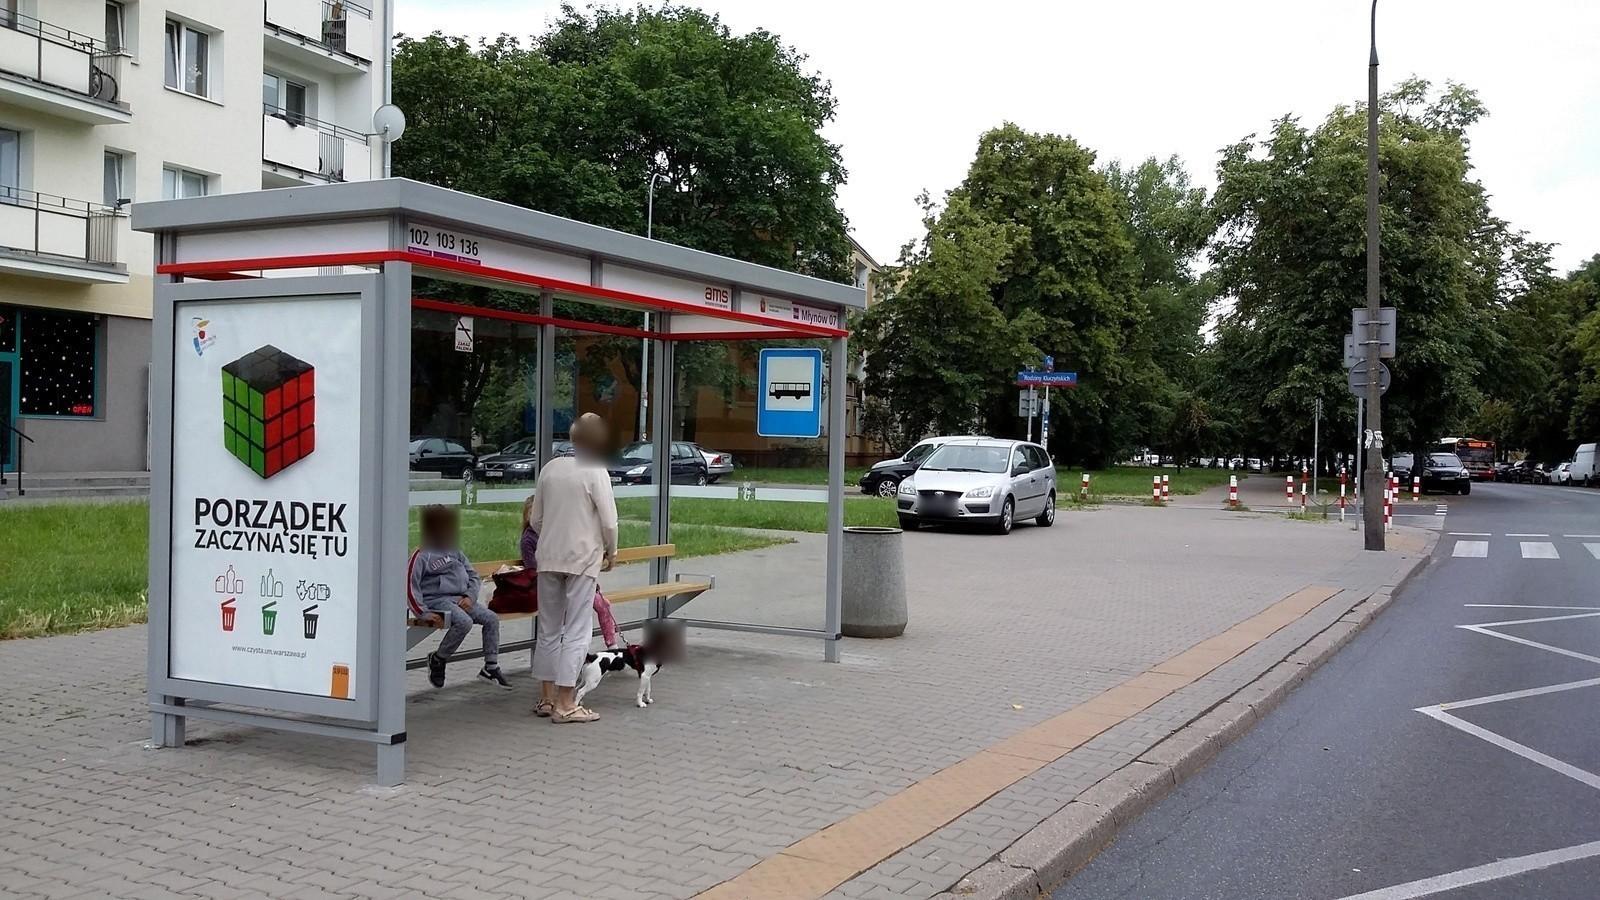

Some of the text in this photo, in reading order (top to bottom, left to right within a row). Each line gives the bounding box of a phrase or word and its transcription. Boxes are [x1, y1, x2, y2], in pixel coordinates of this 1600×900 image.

[410, 228, 479, 256] 102 103 136
[705, 287, 729, 303] ams
[801, 309, 837, 326] Młynów 07
[72, 406, 93, 414] OPEN
[195, 498, 347, 536] PORZĄDEK
[195, 529, 348, 559] ZACZYNA SIĘ TU
[232, 645, 307, 658] www.czysta.um.warszawa.pl
